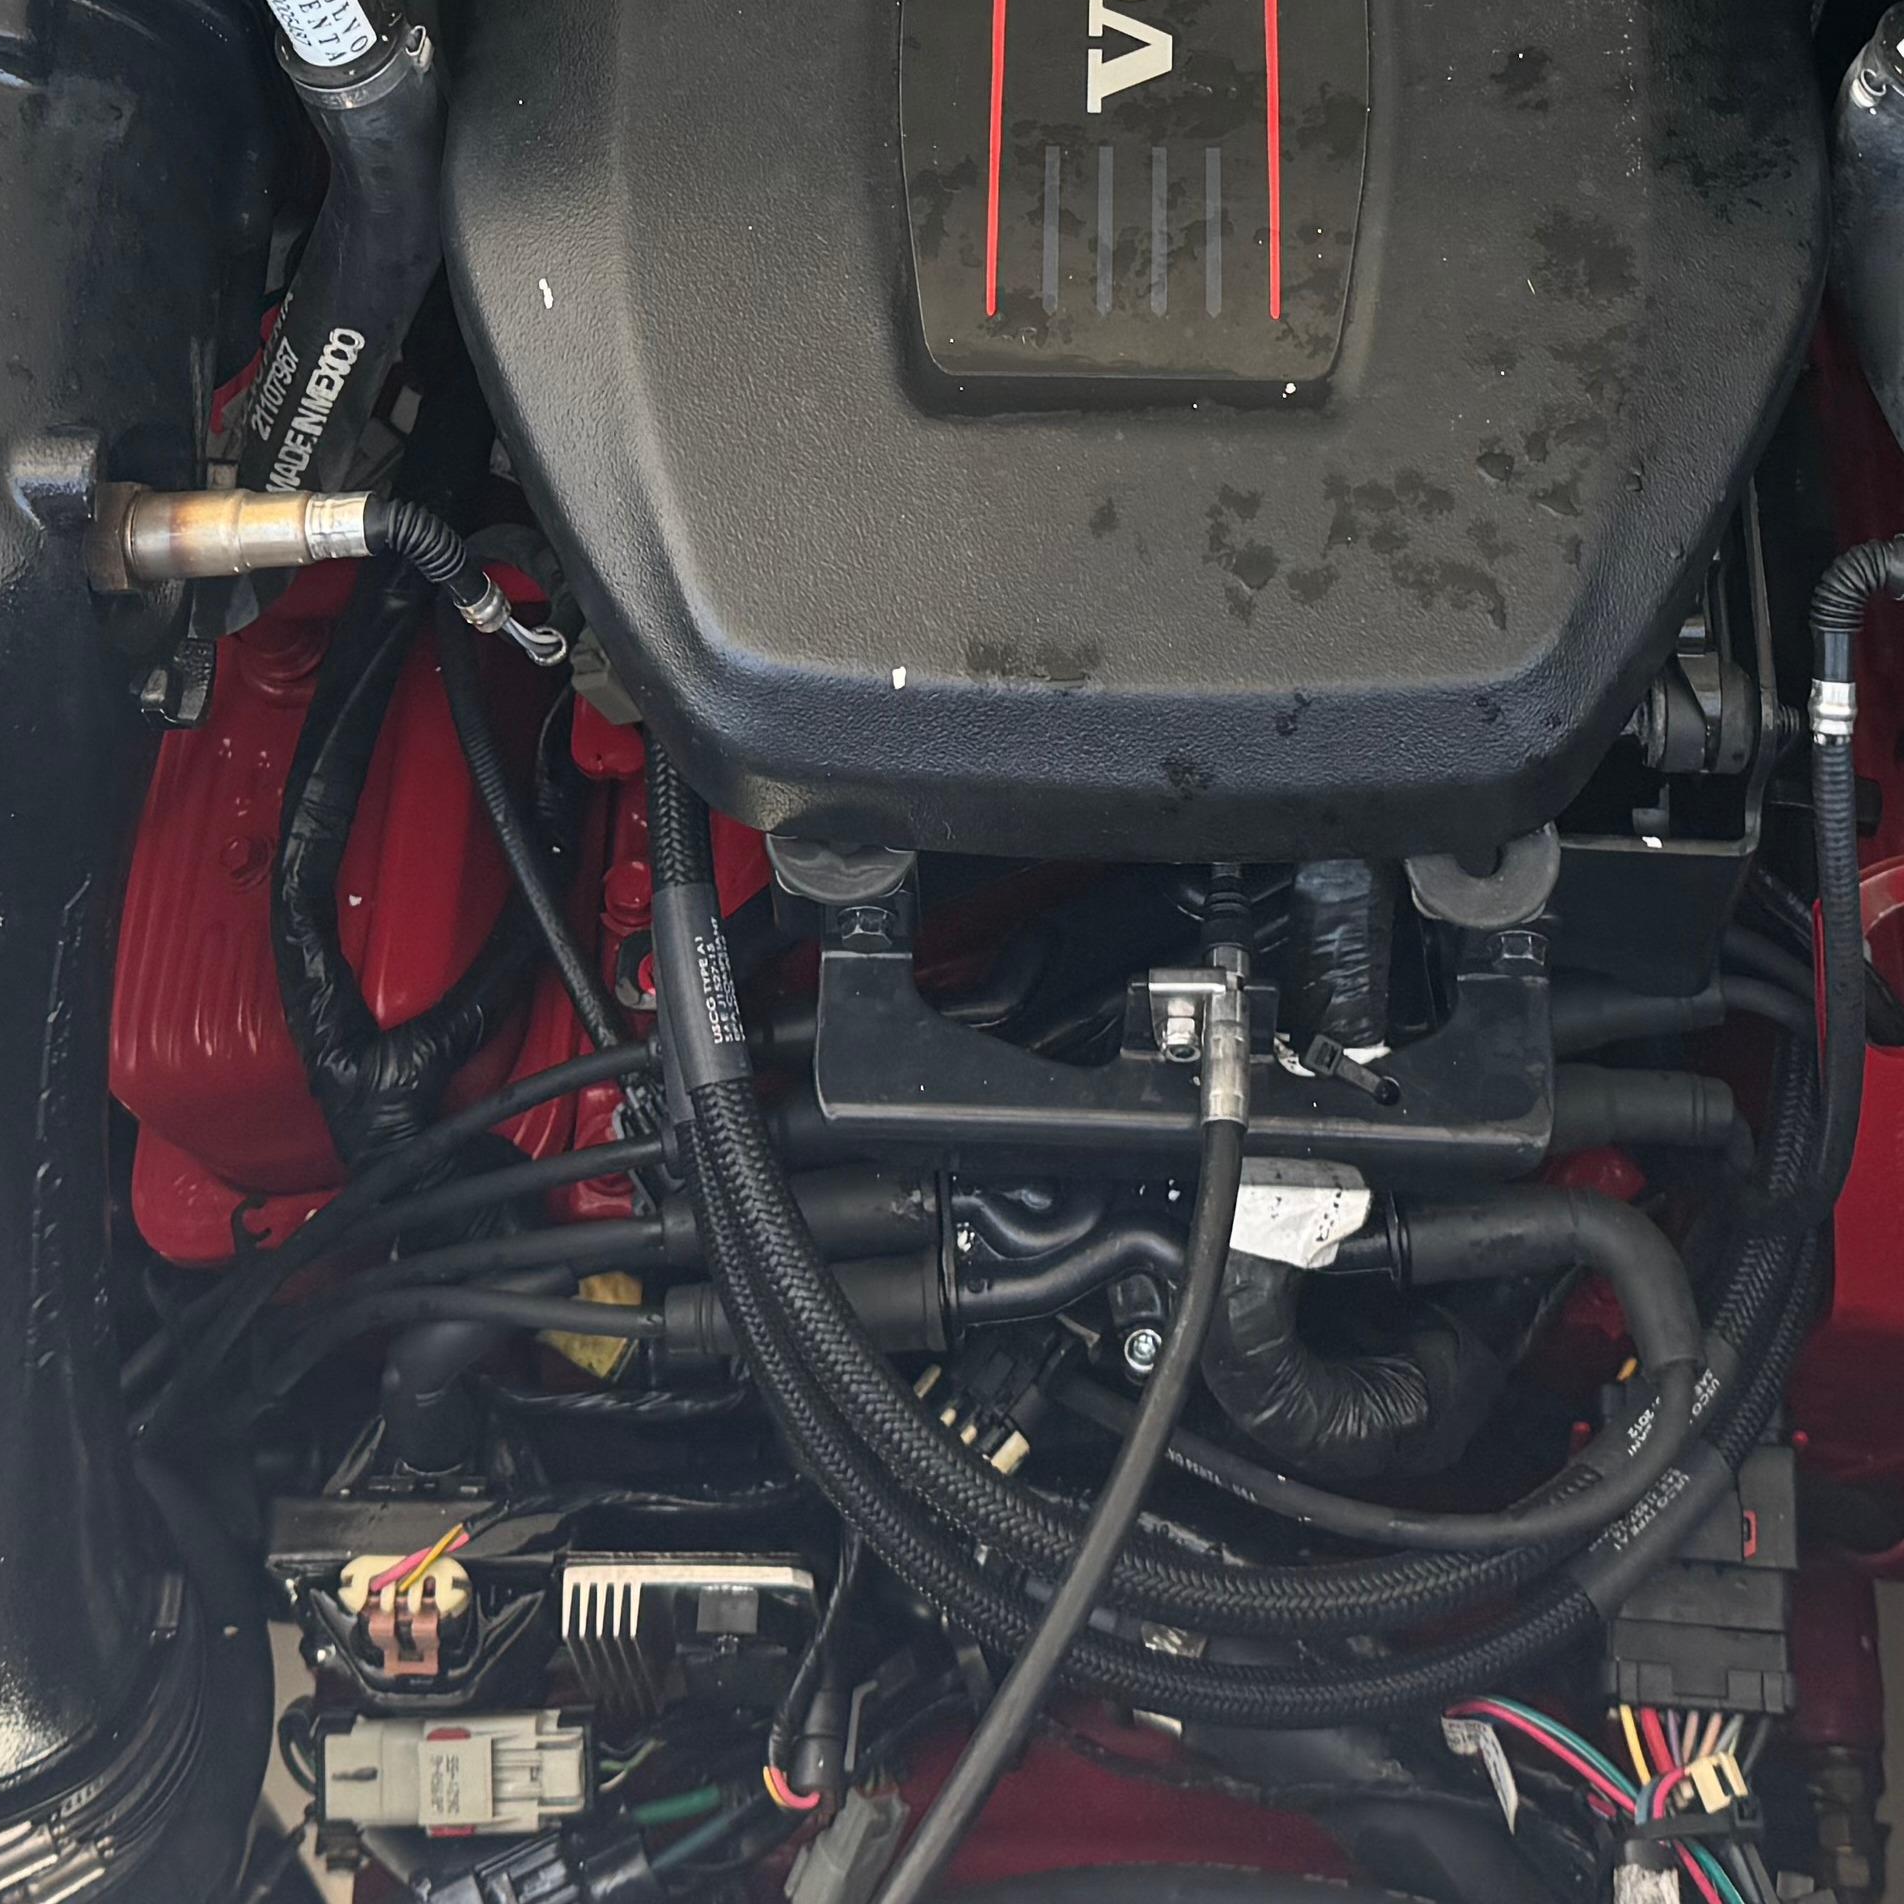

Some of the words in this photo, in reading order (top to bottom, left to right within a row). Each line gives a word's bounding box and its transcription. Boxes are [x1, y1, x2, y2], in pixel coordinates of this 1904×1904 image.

[252, 336, 302, 441] 21107967
[698, 958, 712, 994] TYPE
[706, 996, 724, 1044] USCG
